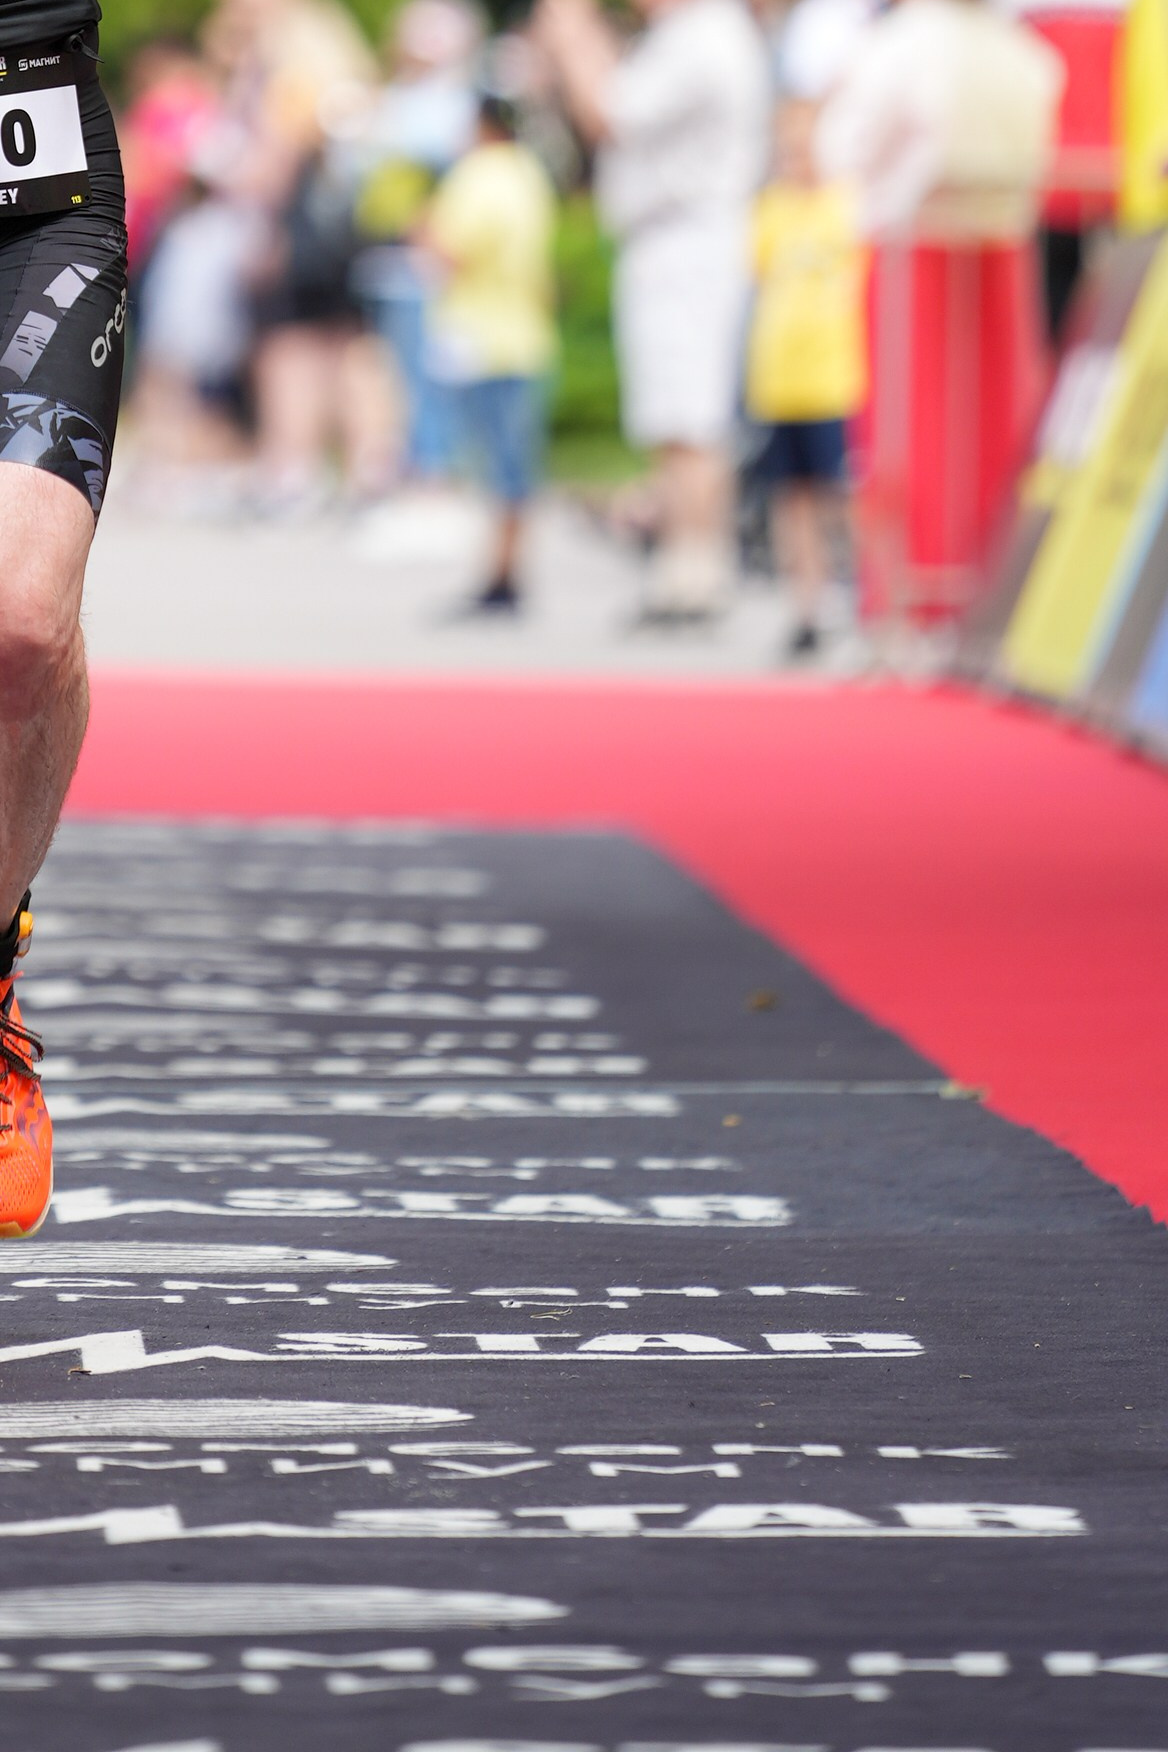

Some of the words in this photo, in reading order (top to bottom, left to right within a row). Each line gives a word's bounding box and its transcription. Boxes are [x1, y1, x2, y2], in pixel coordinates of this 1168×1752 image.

[29, 55, 60, 68] МАГНИТ
[71, 195, 82, 205] 113
[225, 1188, 788, 1220] STAR
[274, 1332, 924, 1352] STAR
[334, 1503, 1077, 1531] STAR
